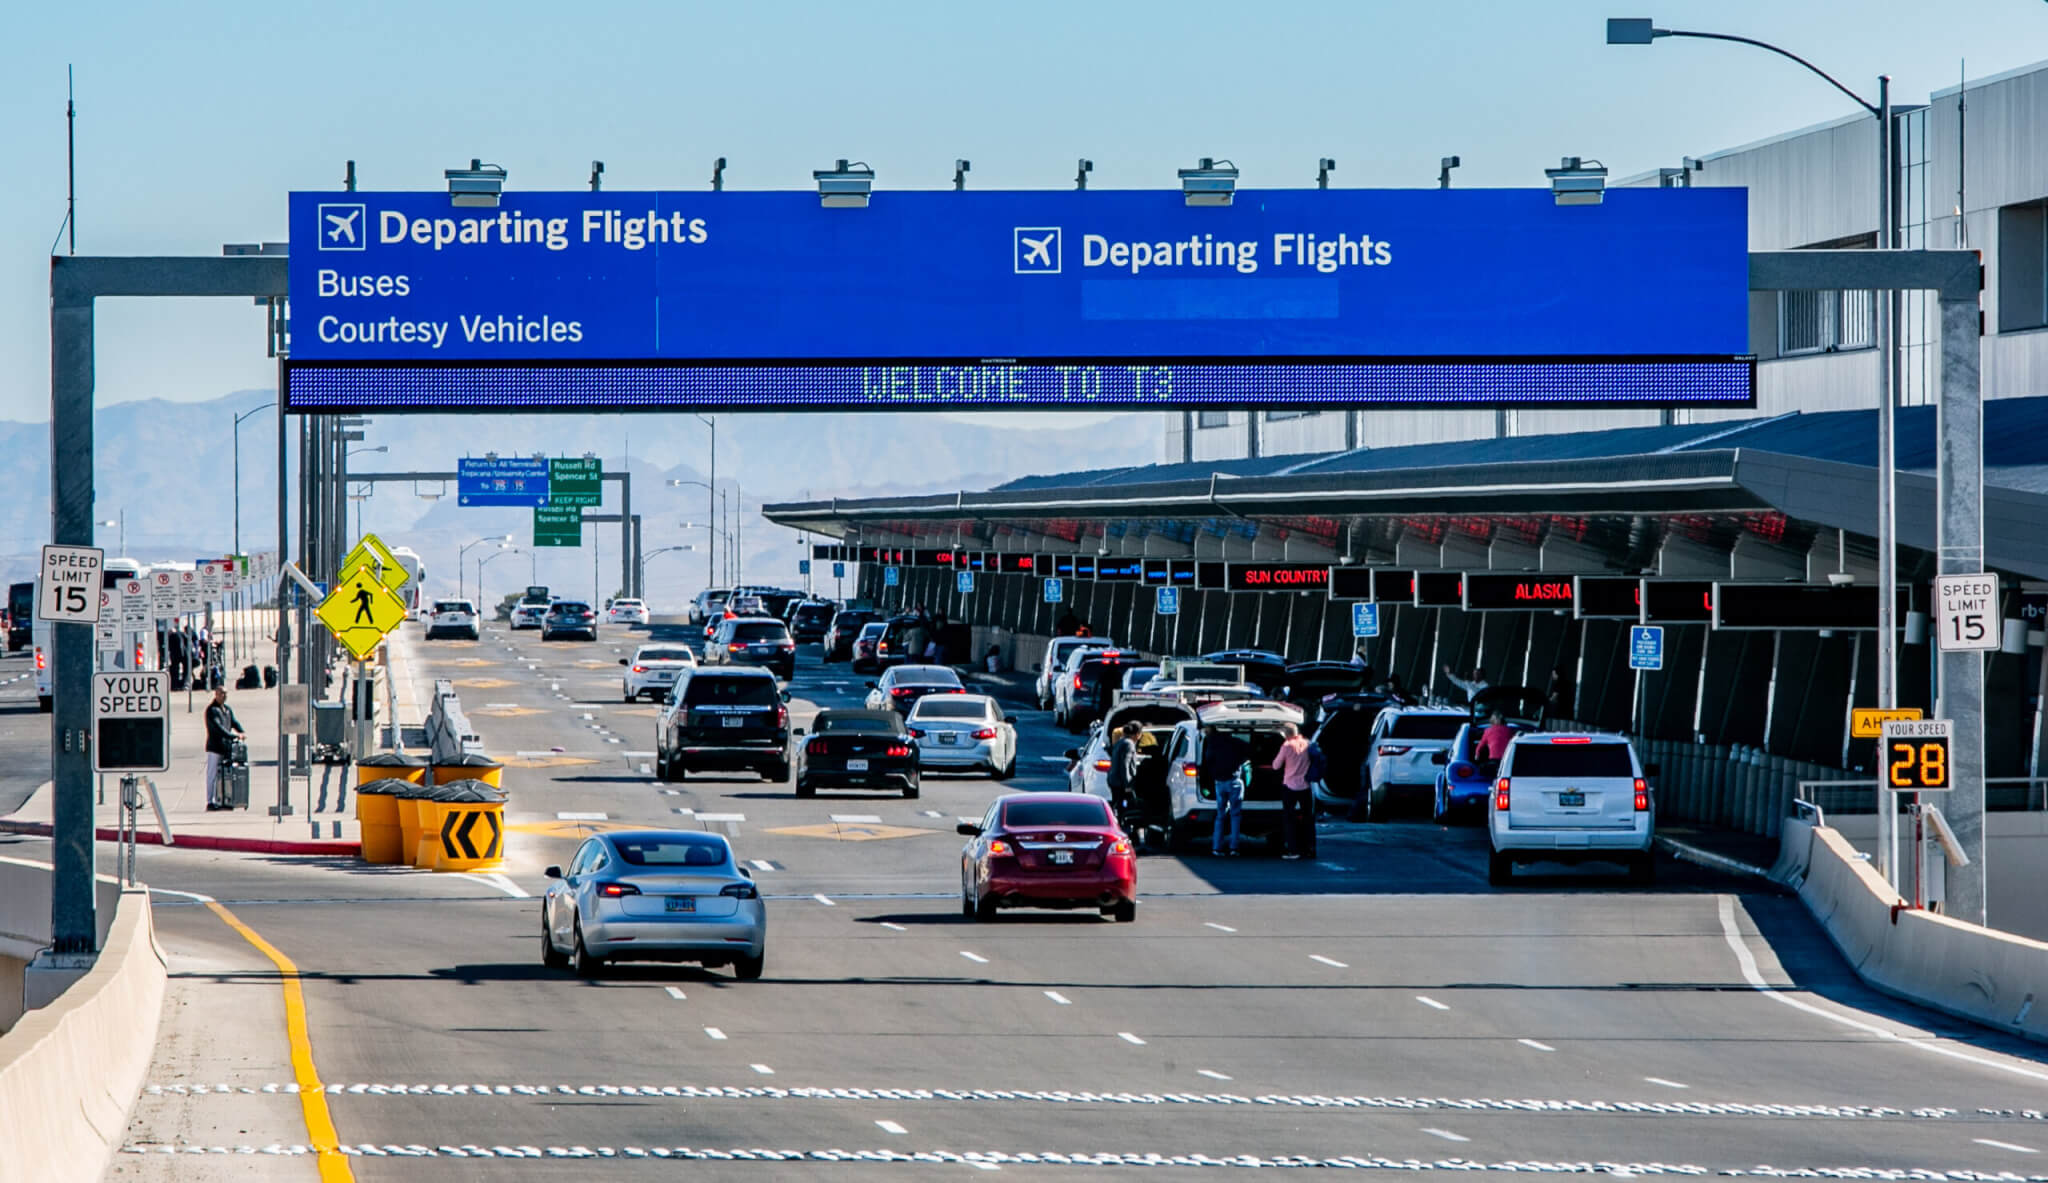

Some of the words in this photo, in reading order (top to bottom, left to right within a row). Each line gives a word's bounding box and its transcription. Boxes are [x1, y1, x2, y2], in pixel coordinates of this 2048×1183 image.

[380, 210, 569, 250] Departing
[583, 210, 708, 250] Flights
[1083, 233, 1258, 274] Departing
[1274, 233, 1392, 273] Flights
[318, 269, 410, 297] Buses
[318, 315, 449, 348] Courtesy
[460, 315, 583, 343] Vehicles
[862, 366, 1028, 399] WELCOME
[1055, 366, 1101, 399] TO
[1127, 366, 1173, 399] T3
[554, 471, 586, 482] Spencer
[48, 554, 98, 569] SPEED
[52, 570, 91, 583] LIMIT
[1245, 570, 1271, 584] SUN
[1273, 570, 1329, 584] COUNTRY
[1514, 583, 1572, 600] ALASKA
[1943, 584, 1991, 596] SPEED
[53, 586, 87, 613] 15
[1948, 599, 1987, 612] LIMIT
[1951, 615, 1985, 641] 15
[104, 677, 159, 695] YOUR
[99, 695, 162, 713] SPEED
[1889, 723, 1914, 735] YOUR
[1918, 723, 1946, 735] SPEED
[1891, 743, 1945, 786] 28
